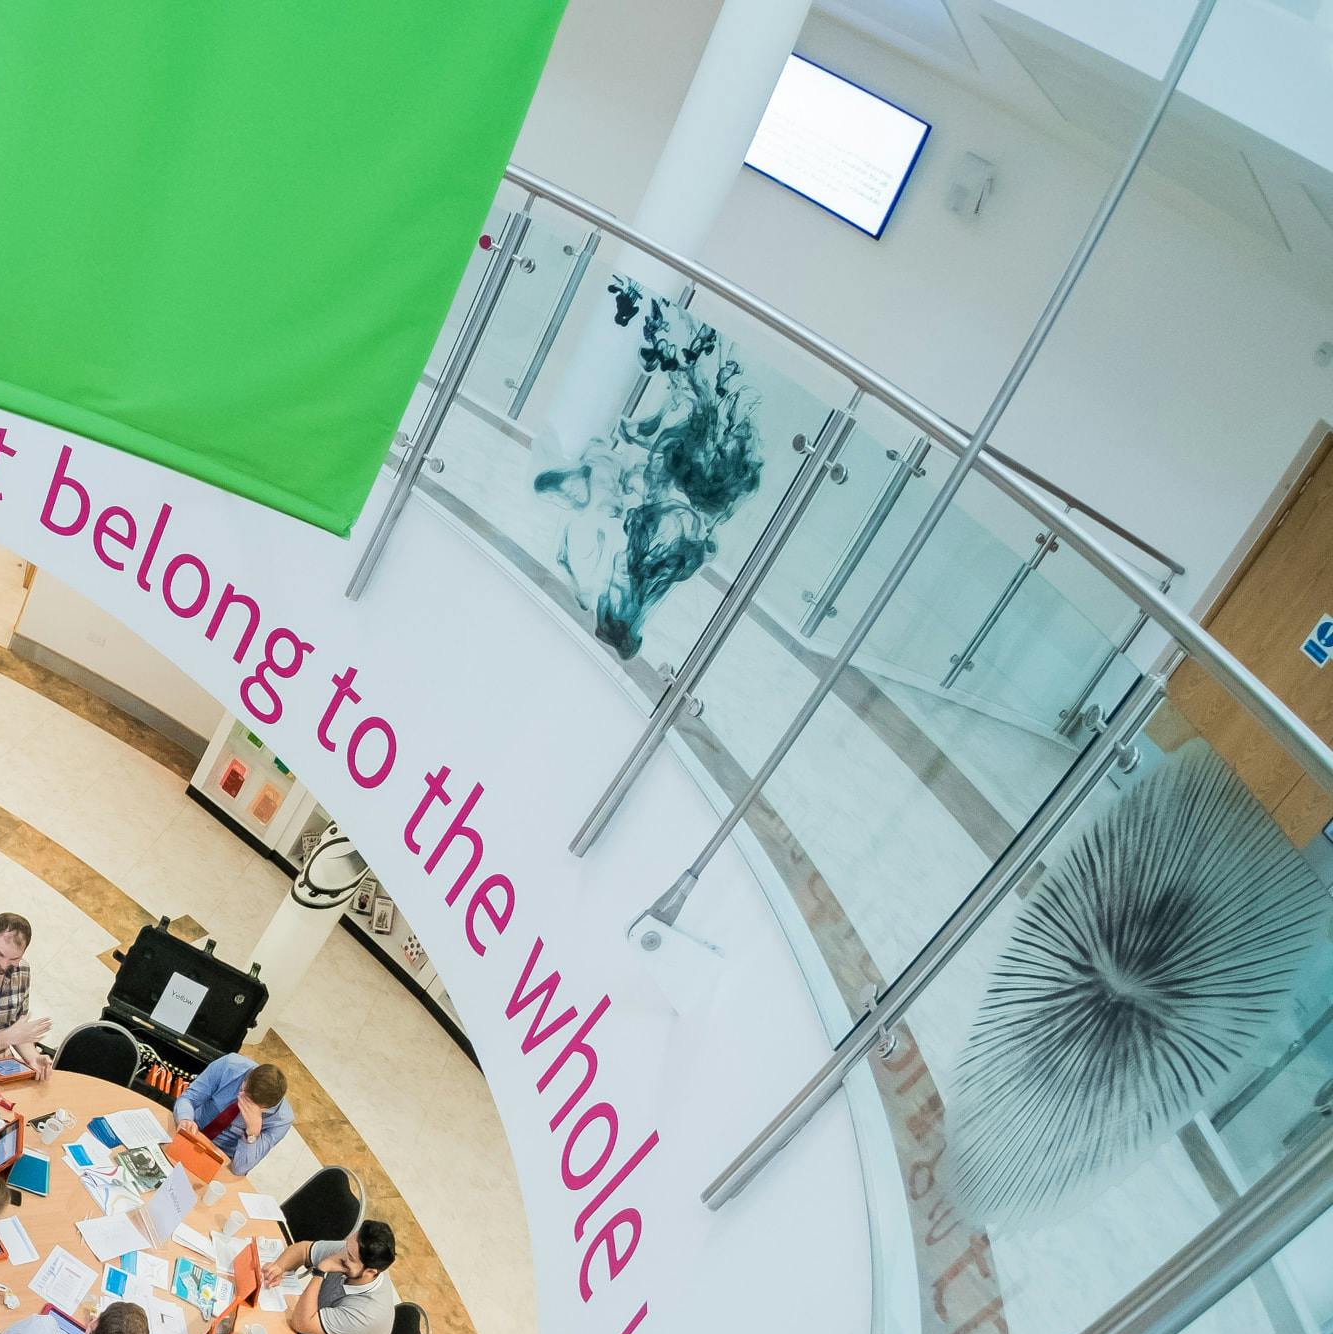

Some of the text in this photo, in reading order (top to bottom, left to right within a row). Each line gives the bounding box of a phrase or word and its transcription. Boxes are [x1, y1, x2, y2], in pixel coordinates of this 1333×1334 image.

[40, 445, 315, 725] belong
[316, 666, 397, 790] to
[403, 765, 516, 957] the
[504, 937, 660, 1302] whole
